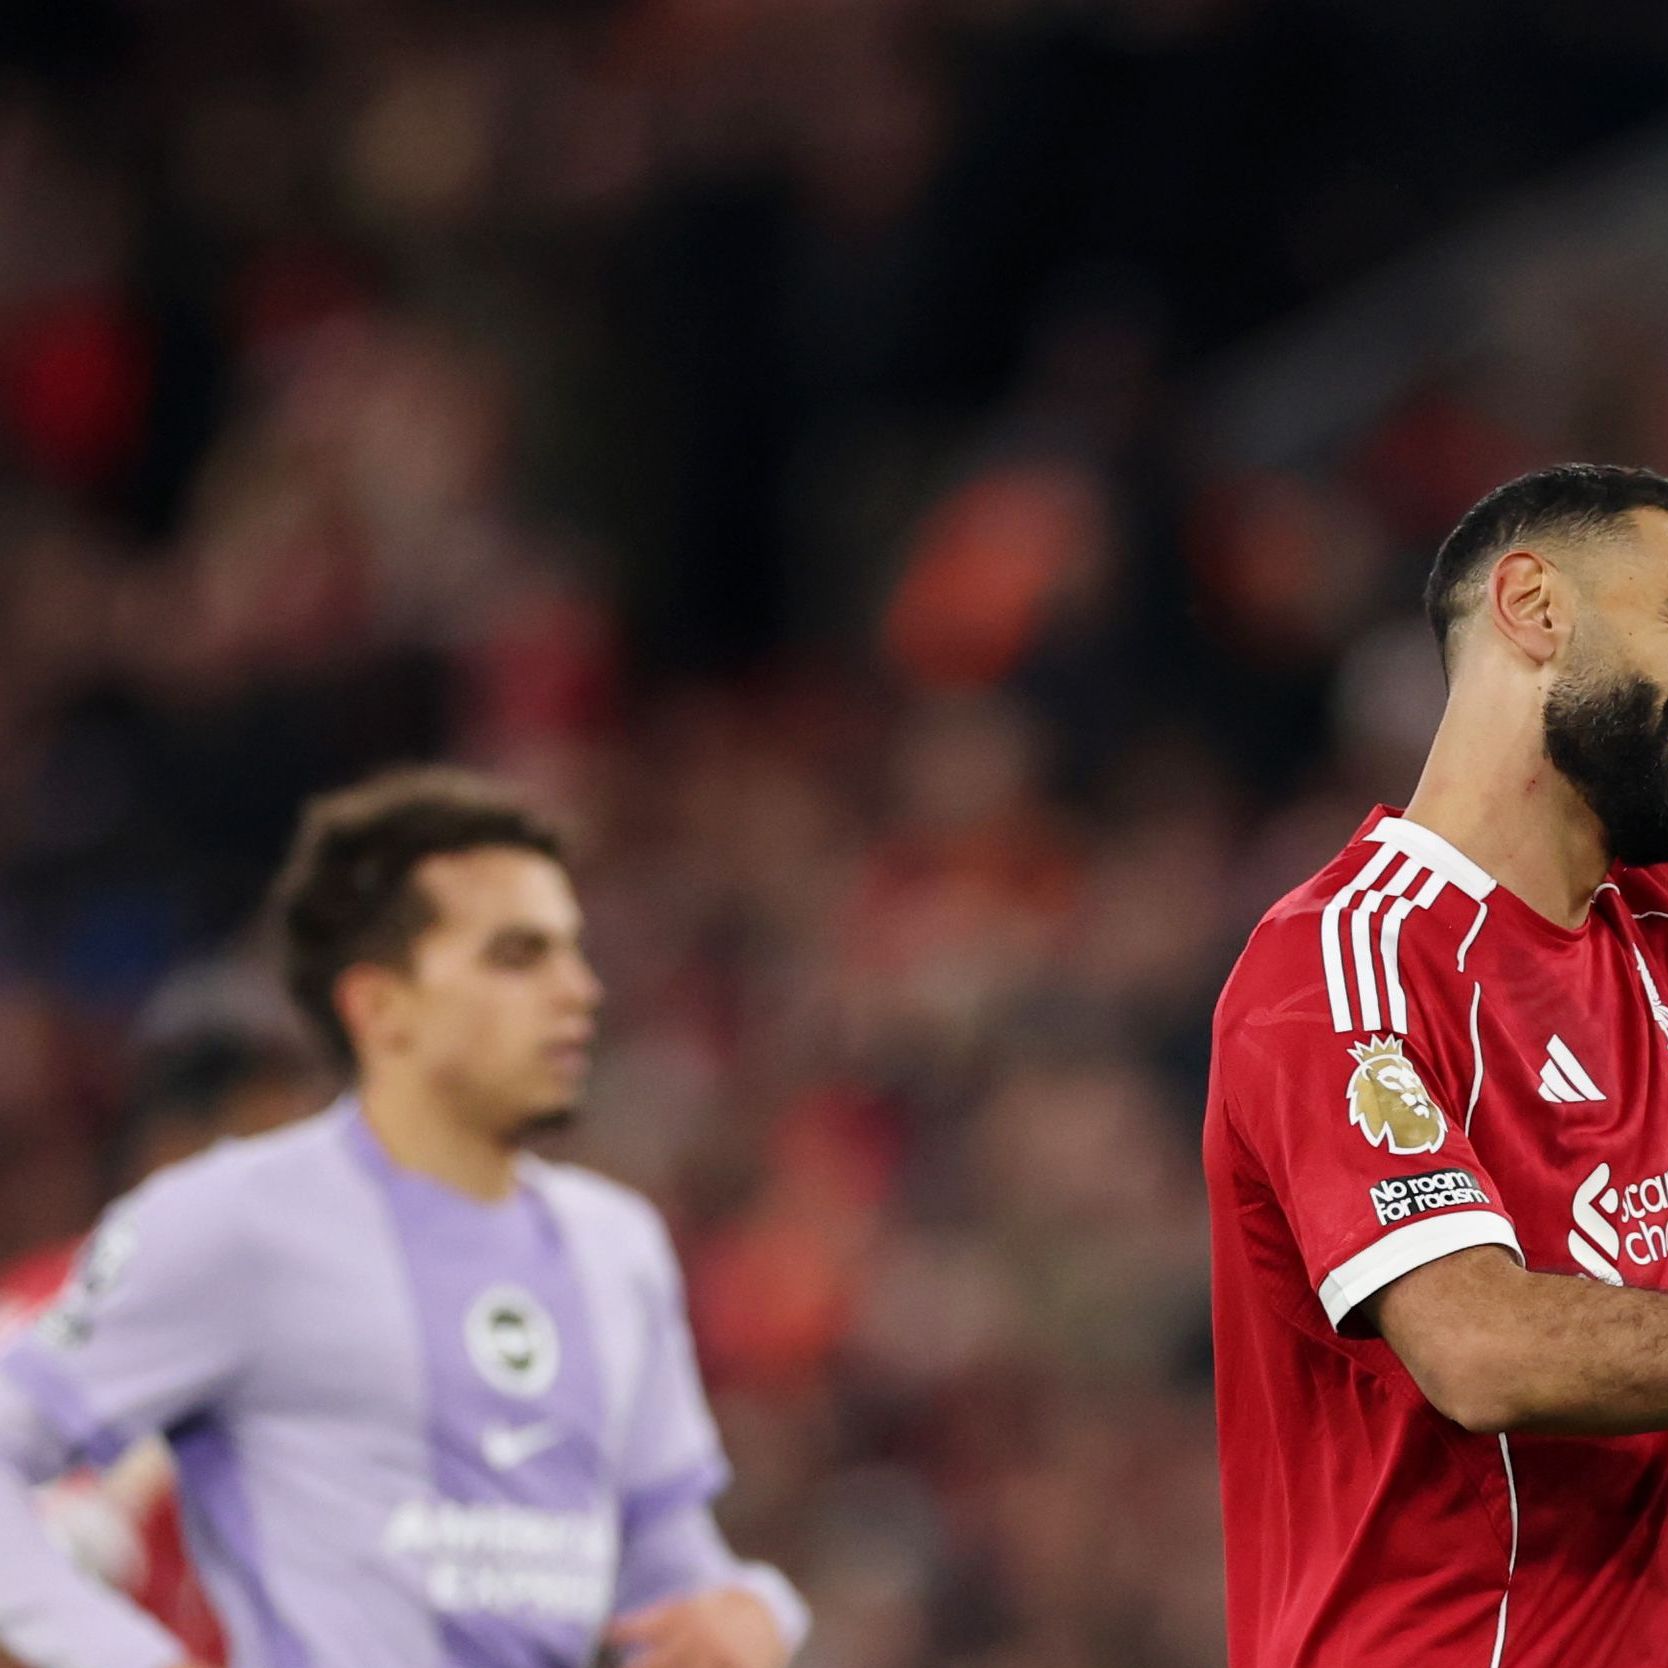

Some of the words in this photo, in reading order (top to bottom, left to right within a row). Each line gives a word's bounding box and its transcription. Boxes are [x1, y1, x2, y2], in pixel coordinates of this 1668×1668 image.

[1369, 1180, 1408, 1207] No
[1407, 1171, 1473, 1194] room
[1376, 1196, 1412, 1226] for
[1414, 1187, 1490, 1212] racism
